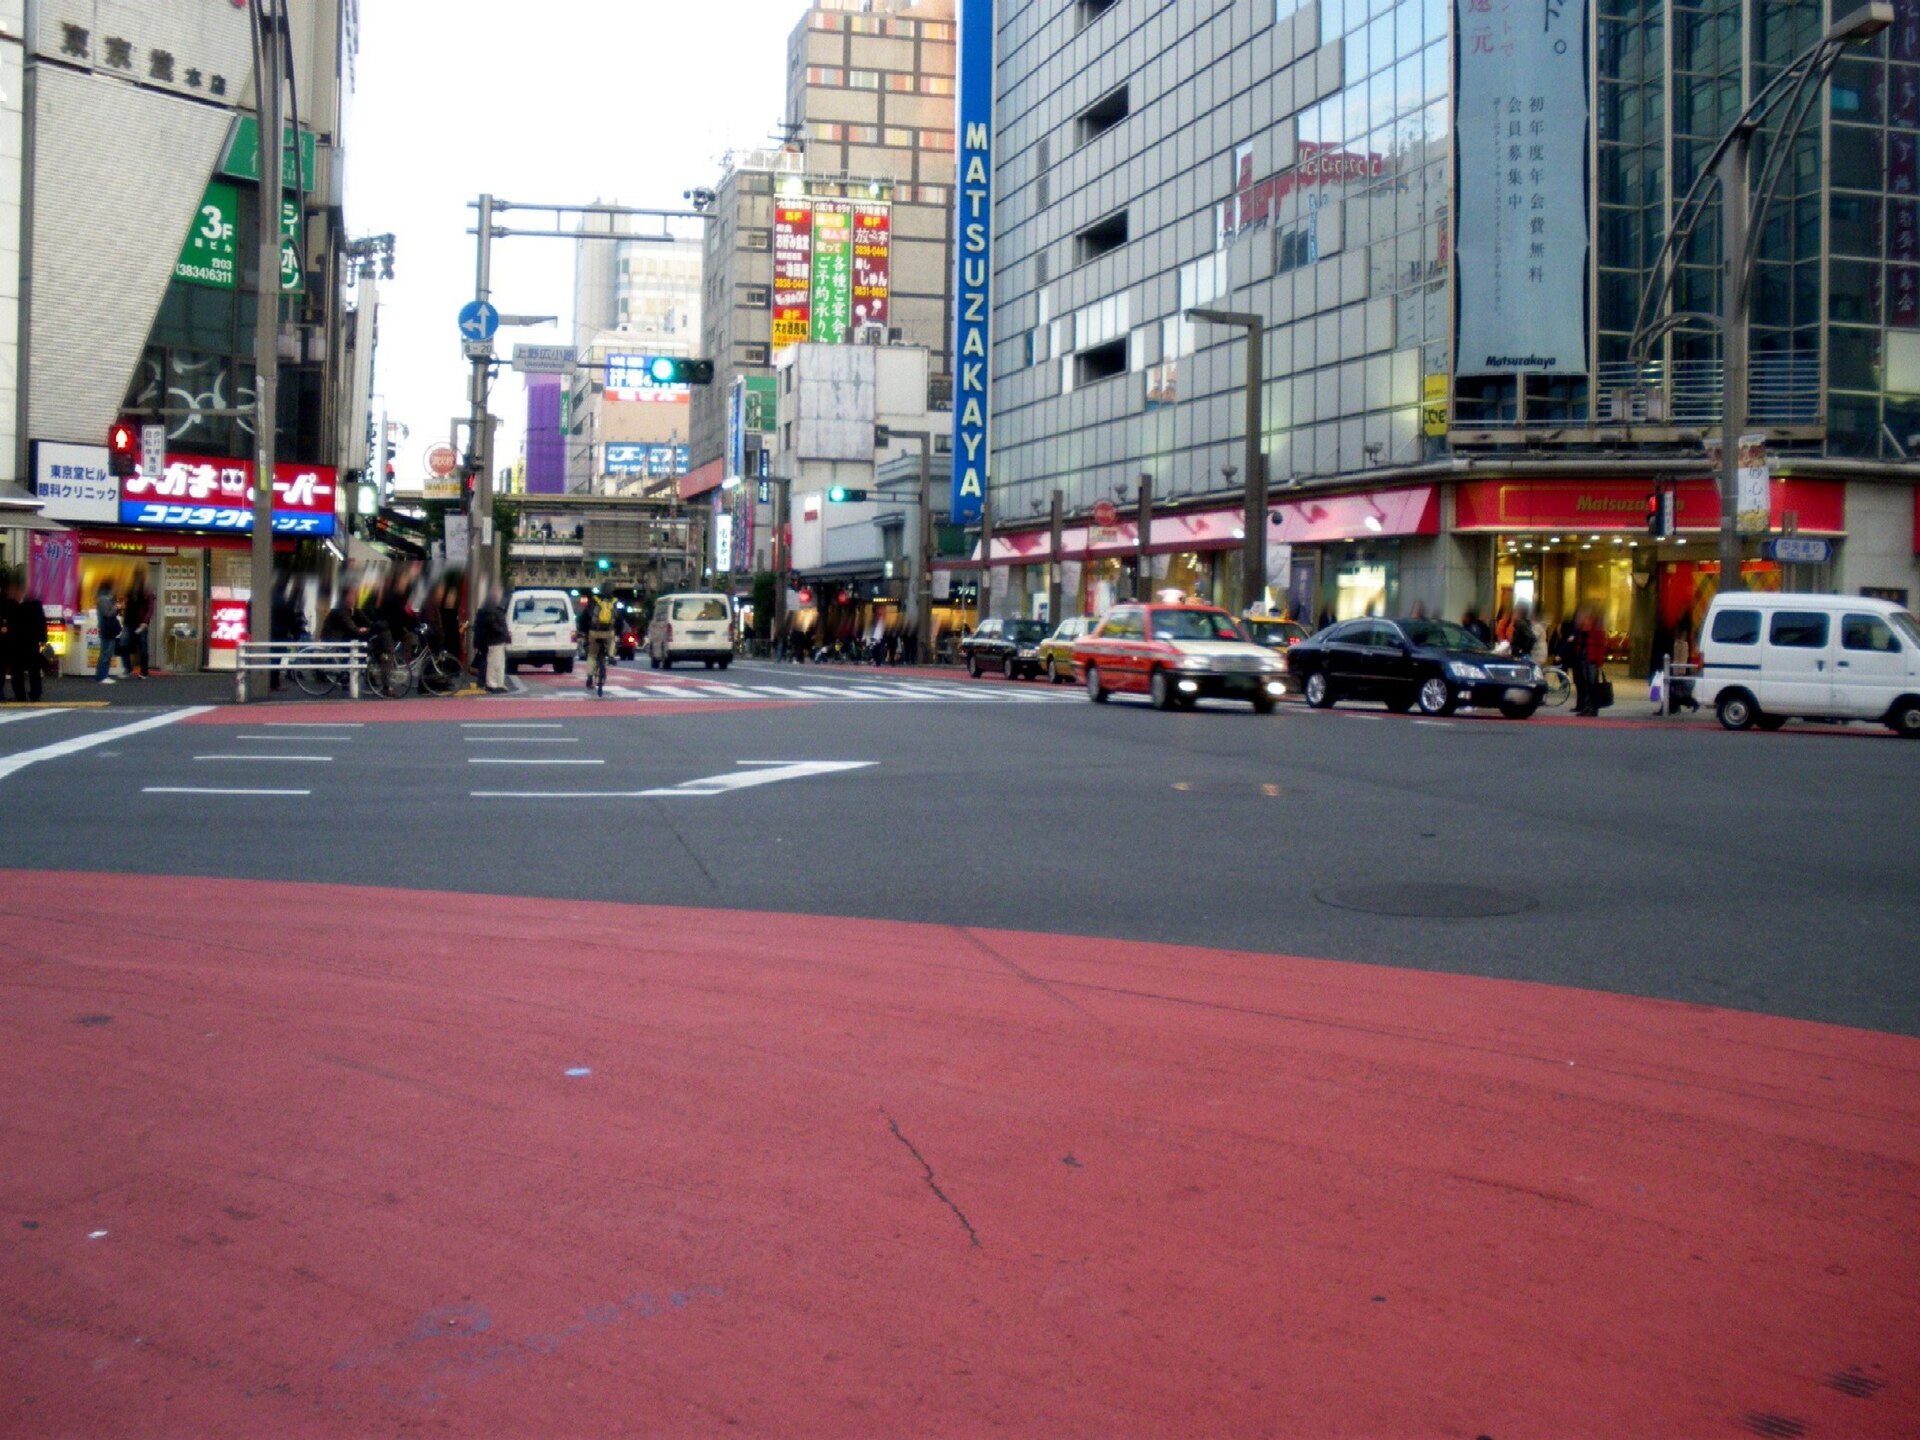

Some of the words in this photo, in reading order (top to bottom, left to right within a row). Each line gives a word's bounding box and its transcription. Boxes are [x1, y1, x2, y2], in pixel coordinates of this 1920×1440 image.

[1508, 96, 1523, 209] 会員募集中
[1528, 96, 1545, 283] 初年度年会費無料
[200, 204, 233, 240] 3F
[960, 121, 988, 498] MATSUZAKAYA
[1485, 353, 1557, 370] Matsuzakaya
[50, 464, 106, 481] 東京堂ビル
[38, 483, 117, 501] 眼科クリニック
